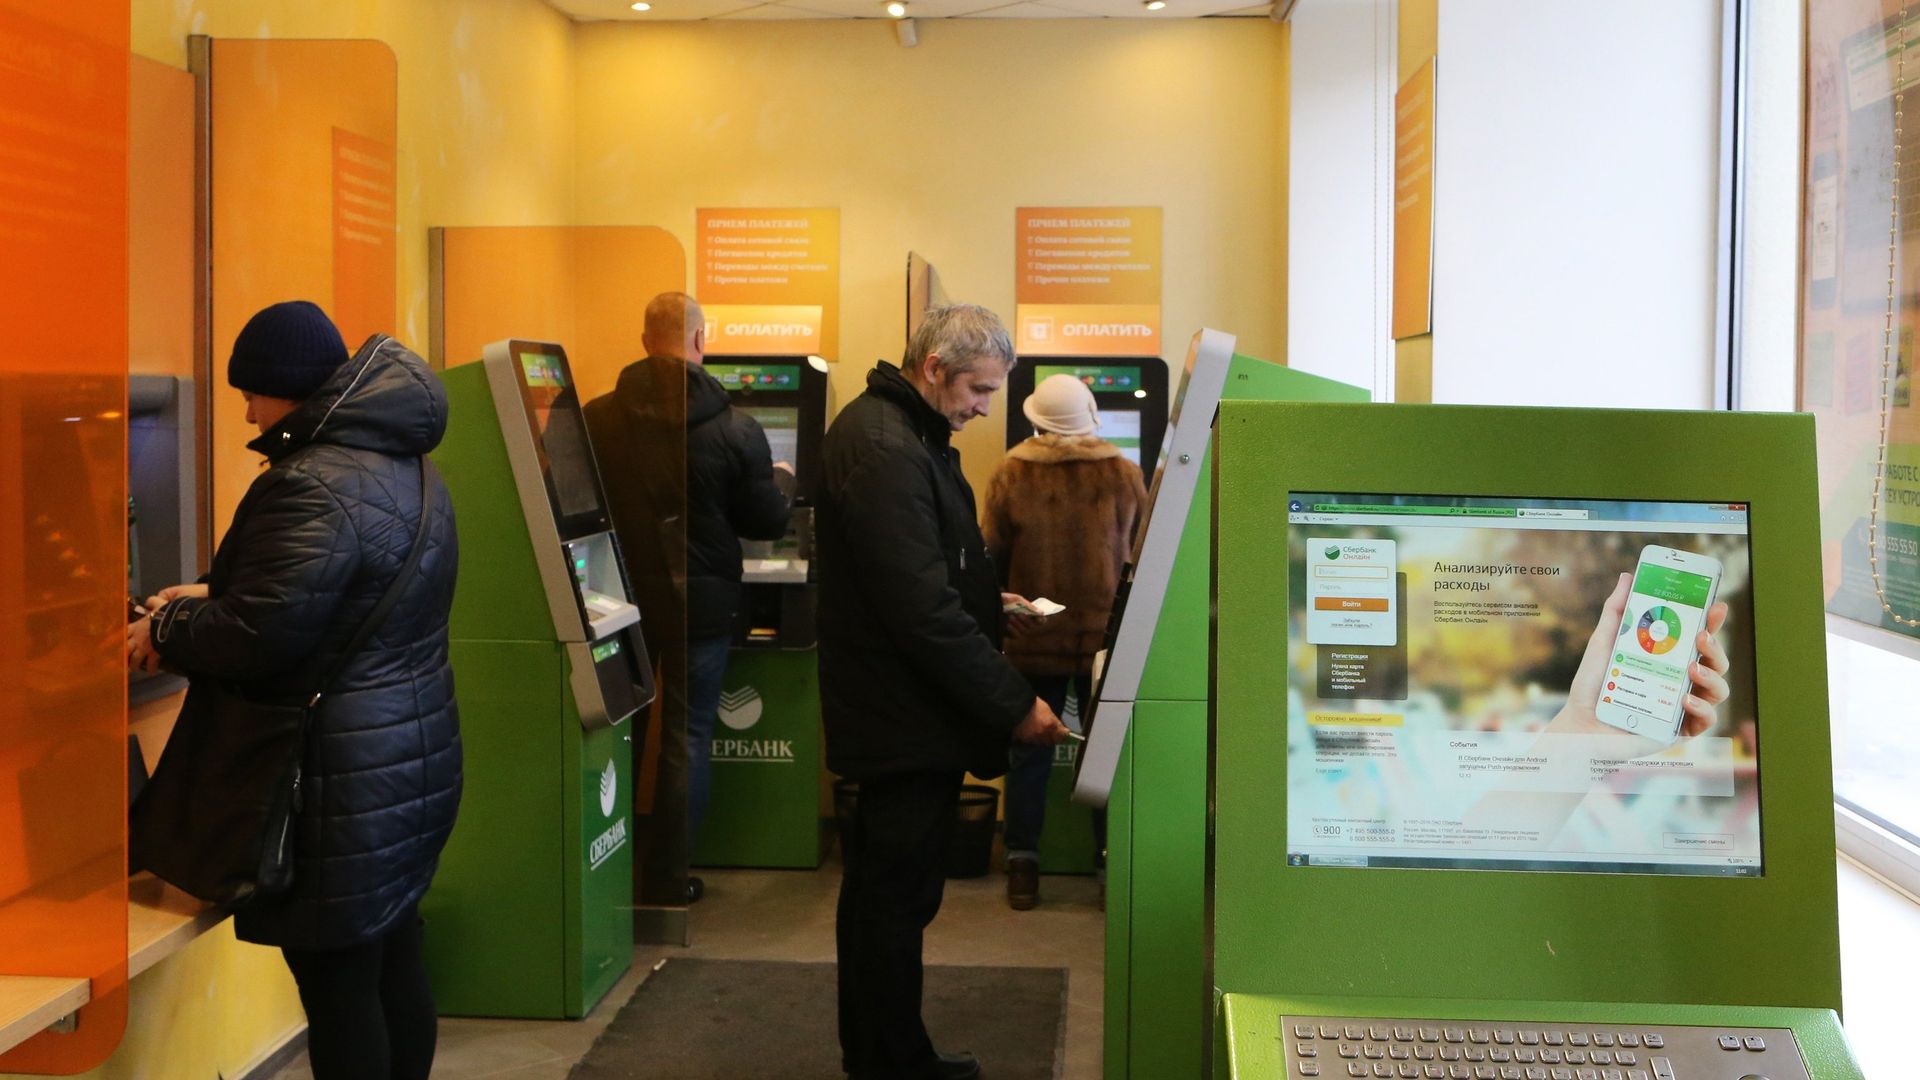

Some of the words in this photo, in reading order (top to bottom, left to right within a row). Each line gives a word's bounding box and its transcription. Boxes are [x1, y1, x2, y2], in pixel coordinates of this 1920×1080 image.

[725, 323, 813, 336] ОПЛАТИТЬ
[1062, 323, 1152, 336] ОПЛАТИТЬ
[1343, 546, 1376, 554] Сбербанк
[1887, 536, 1899, 552] 555
[1899, 538, 1908, 554] 55
[1908, 540, 1918, 556] 50
[1434, 562, 1527, 576] Анализируйте
[1530, 566, 1560, 575] свои
[1434, 580, 1490, 592] расходы
[1342, 600, 1361, 608] Войти
[1434, 601, 1482, 609] Воспользуйтесь
[1484, 602, 1512, 610] сервисом
[1434, 616, 1463, 624] Сбербанк
[1331, 652, 1368, 660] Регистрация
[711, 740, 794, 758] ЕРБАНК
[1323, 826, 1341, 835] 900
[590, 816, 626, 864] СБЕРБАНК
